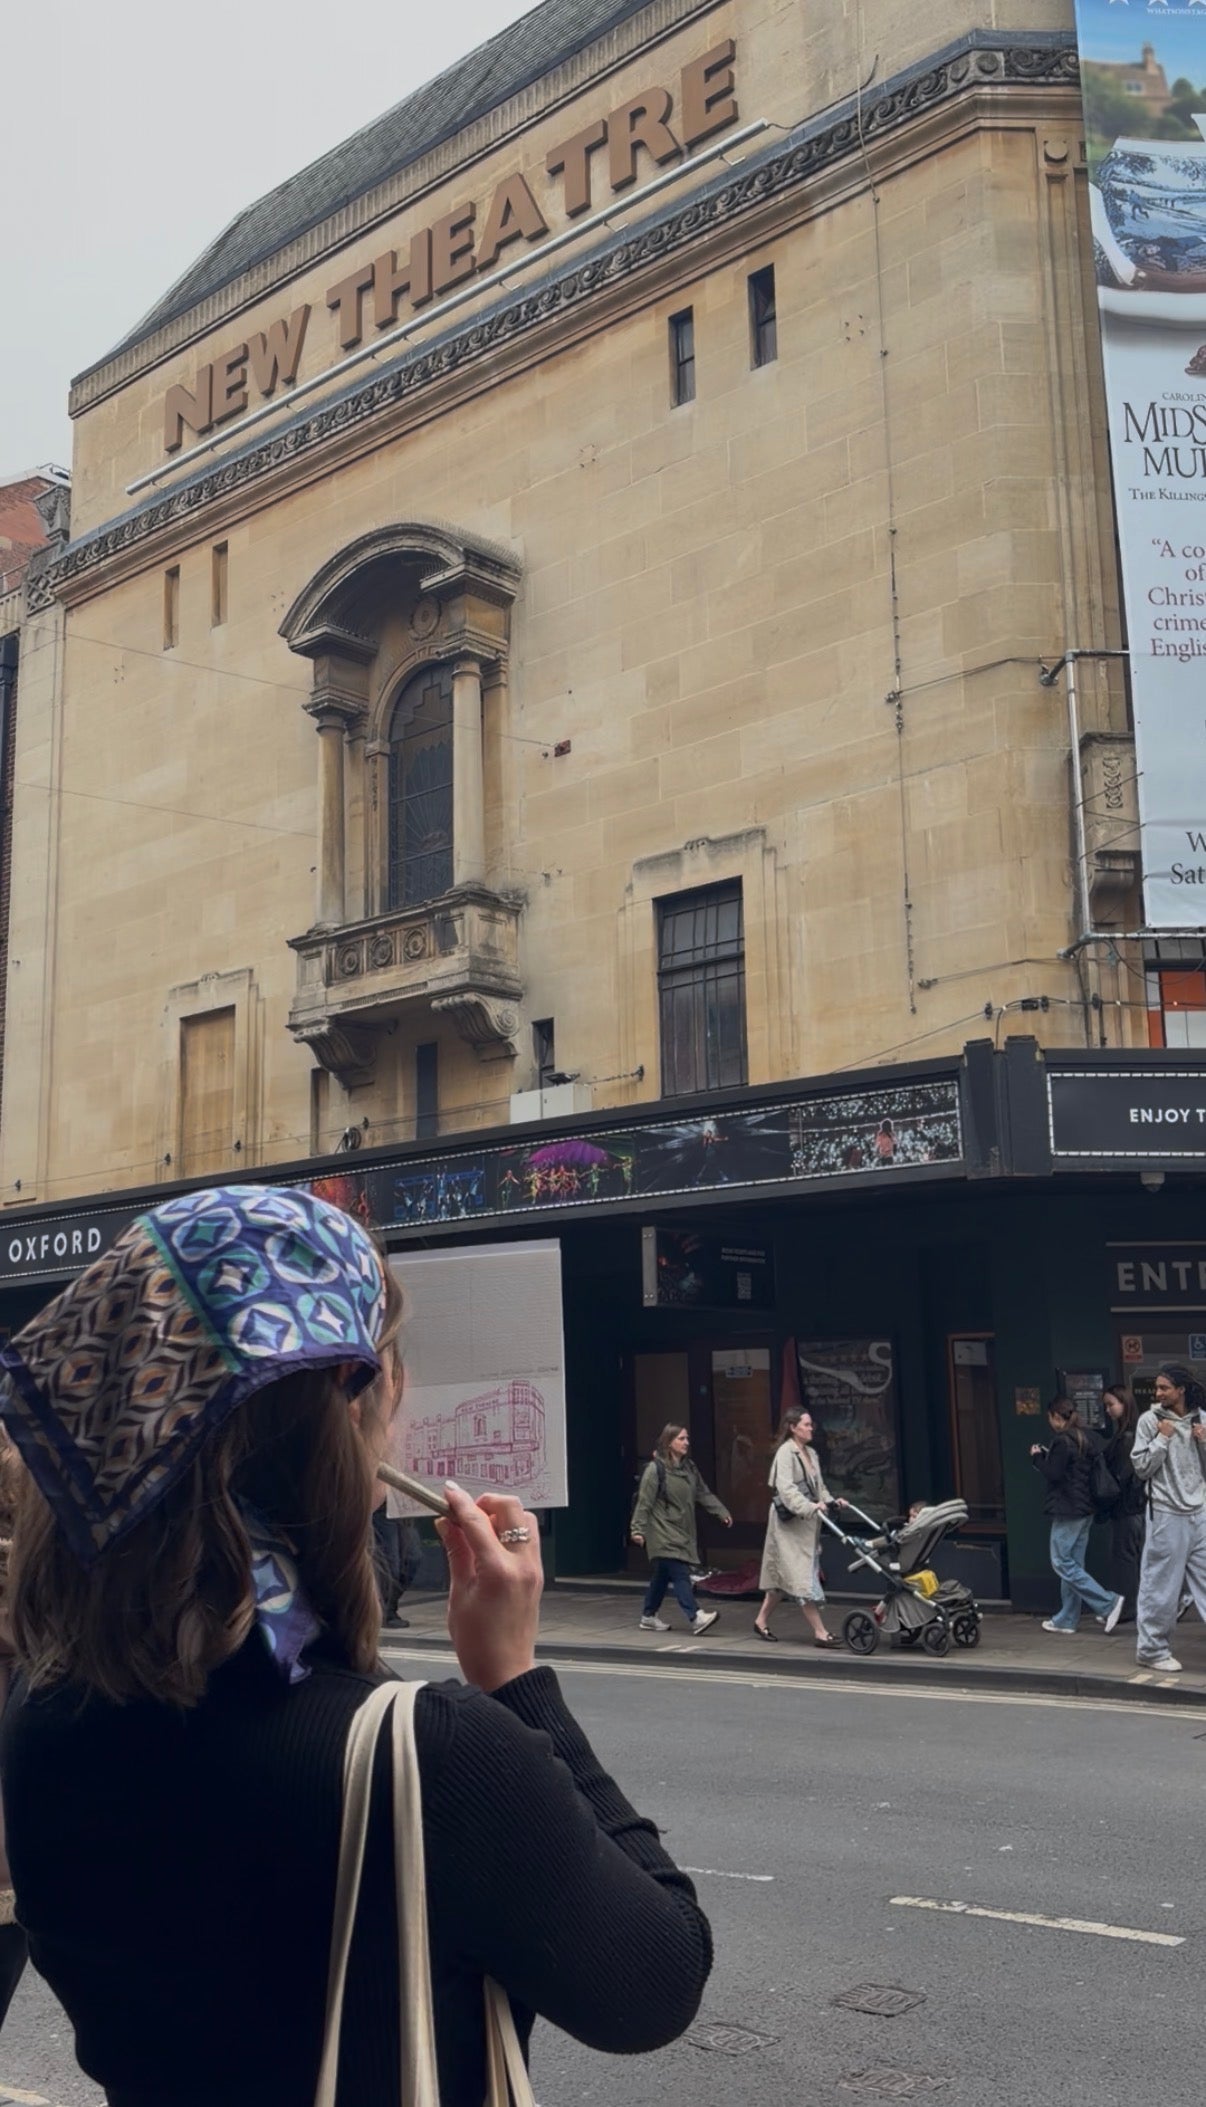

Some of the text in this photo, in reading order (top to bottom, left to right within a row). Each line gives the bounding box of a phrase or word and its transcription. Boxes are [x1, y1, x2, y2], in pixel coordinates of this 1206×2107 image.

[164, 38, 739, 454] NEW THEATRE
[1159, 488, 1206, 502] KILLING
[1148, 587, 1206, 606] Chris
[1171, 862, 1206, 885] Sat
[1129, 1108, 1191, 1123] ENJOY
[8, 1227, 102, 1263] OXFORD
